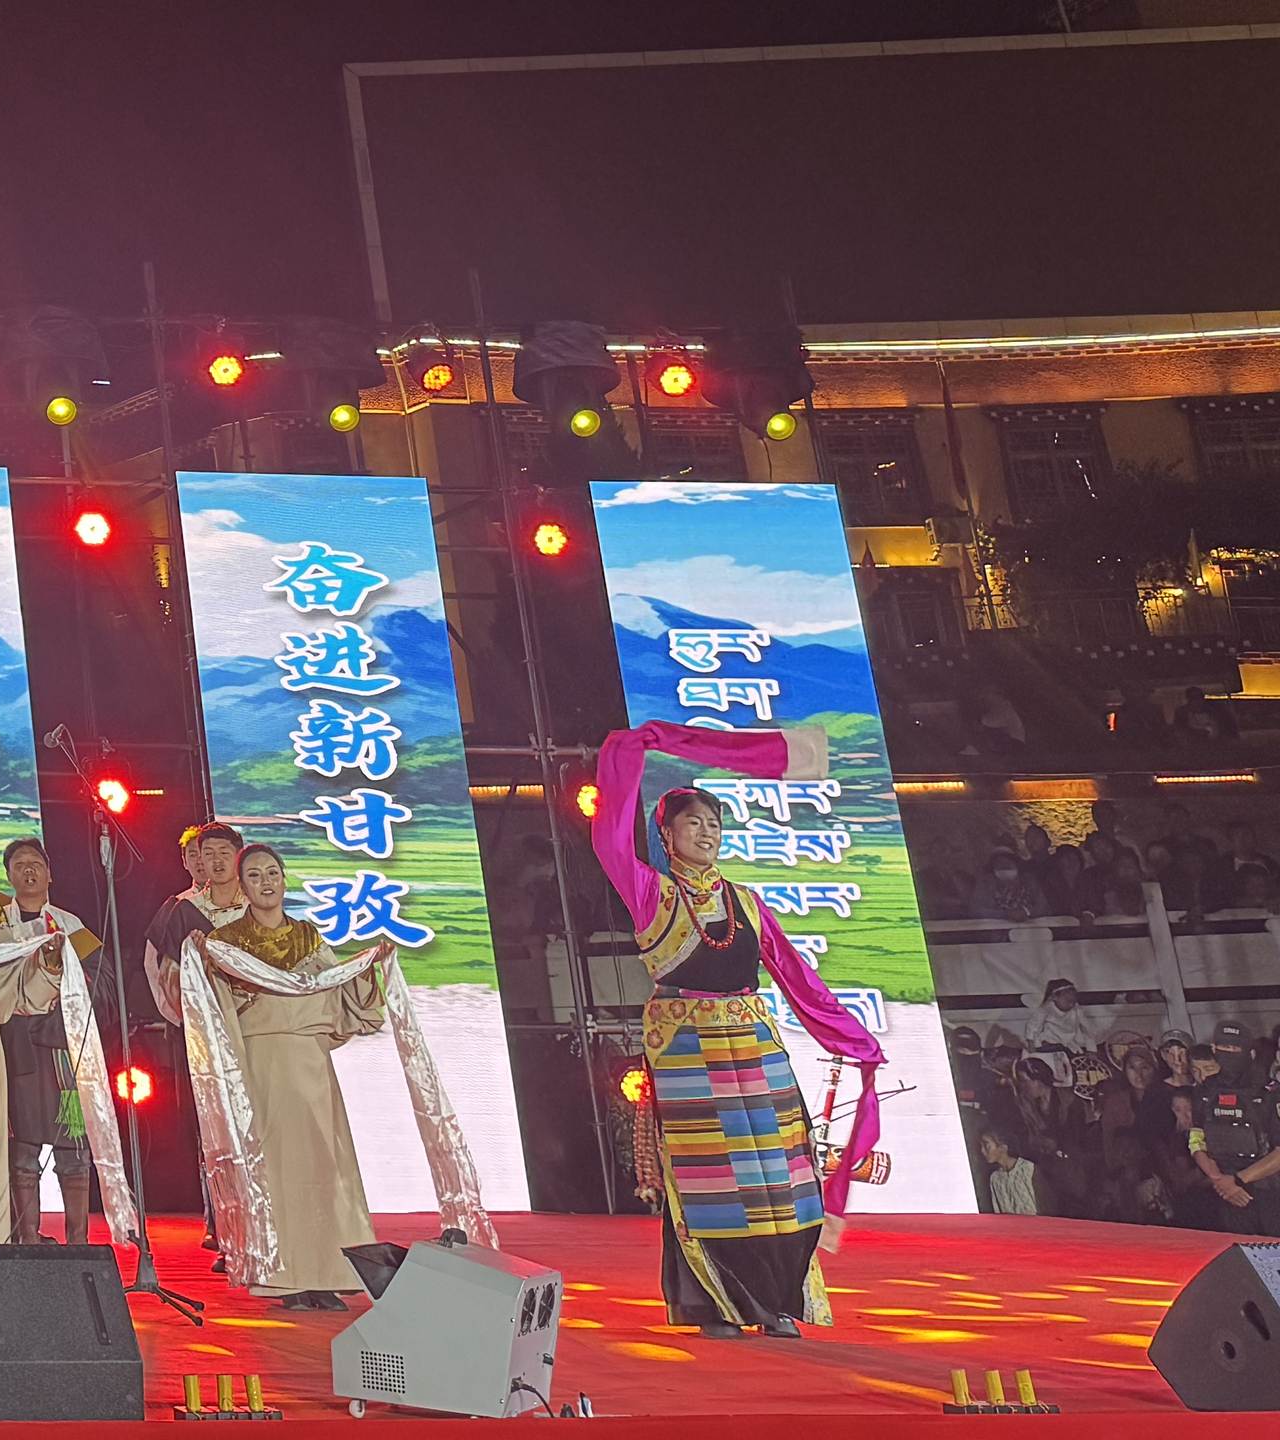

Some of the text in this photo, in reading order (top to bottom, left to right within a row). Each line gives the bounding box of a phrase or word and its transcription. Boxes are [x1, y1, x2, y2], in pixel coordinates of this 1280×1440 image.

[263, 541, 436, 948] 奋进新甘孜
